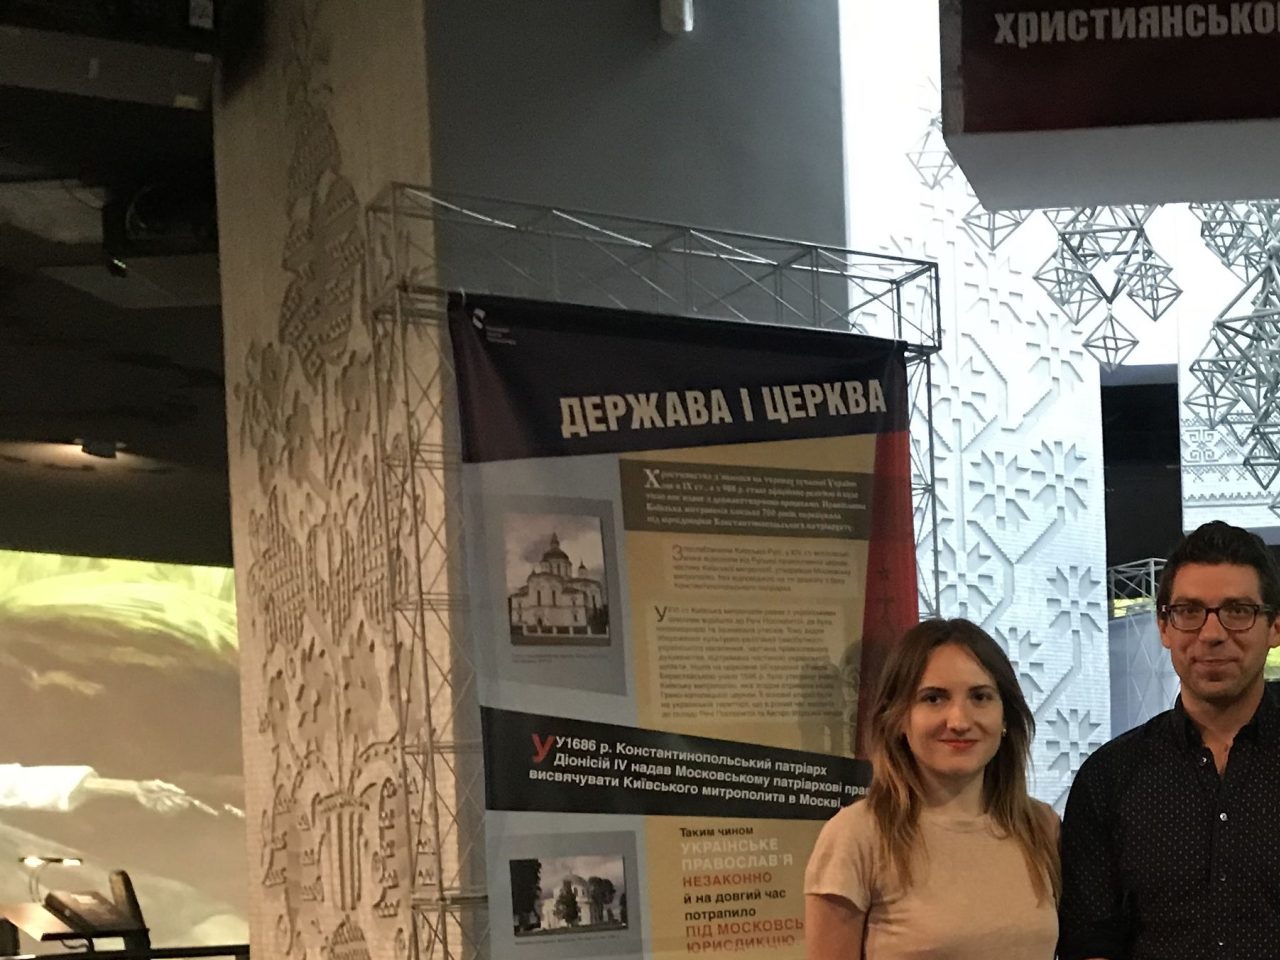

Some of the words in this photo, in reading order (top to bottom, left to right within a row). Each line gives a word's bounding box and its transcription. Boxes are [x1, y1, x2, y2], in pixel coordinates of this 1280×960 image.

[559, 389, 734, 439] ДЕРЖАВА
[740, 387, 754, 422] І
[761, 378, 887, 424] ЦЕРКВА
[600, 743, 612, 754] р.
[616, 742, 772, 770] Константинопольський
[775, 761, 828, 778] патріарх
[554, 752, 611, 770] Діонісій
[614, 759, 628, 771] IV
[631, 762, 672, 776] надав
[675, 765, 770, 788] Московському
[773, 777, 842, 793] патріархові
[529, 769, 620, 787] висвячувати
[623, 776, 699, 795] Київського
[702, 786, 785, 804] митрополита
[789, 796, 796, 804] в
[680, 827, 715, 838] Таким
[718, 827, 754, 836] чином
[680, 837, 778, 855] УКРАЇНСЬКЕ
[682, 854, 793, 871] ПРАВОСЛАВ'Я
[683, 871, 772, 888] НЕЗАКОННО
[684, 893, 691, 904] й
[696, 895, 712, 903] на
[715, 889, 761, 904] довгий
[765, 889, 786, 899] час
[685, 908, 756, 921] потрапило
[686, 925, 713, 938] ПІД
[718, 918, 804, 935] МОСКОВСЬ
